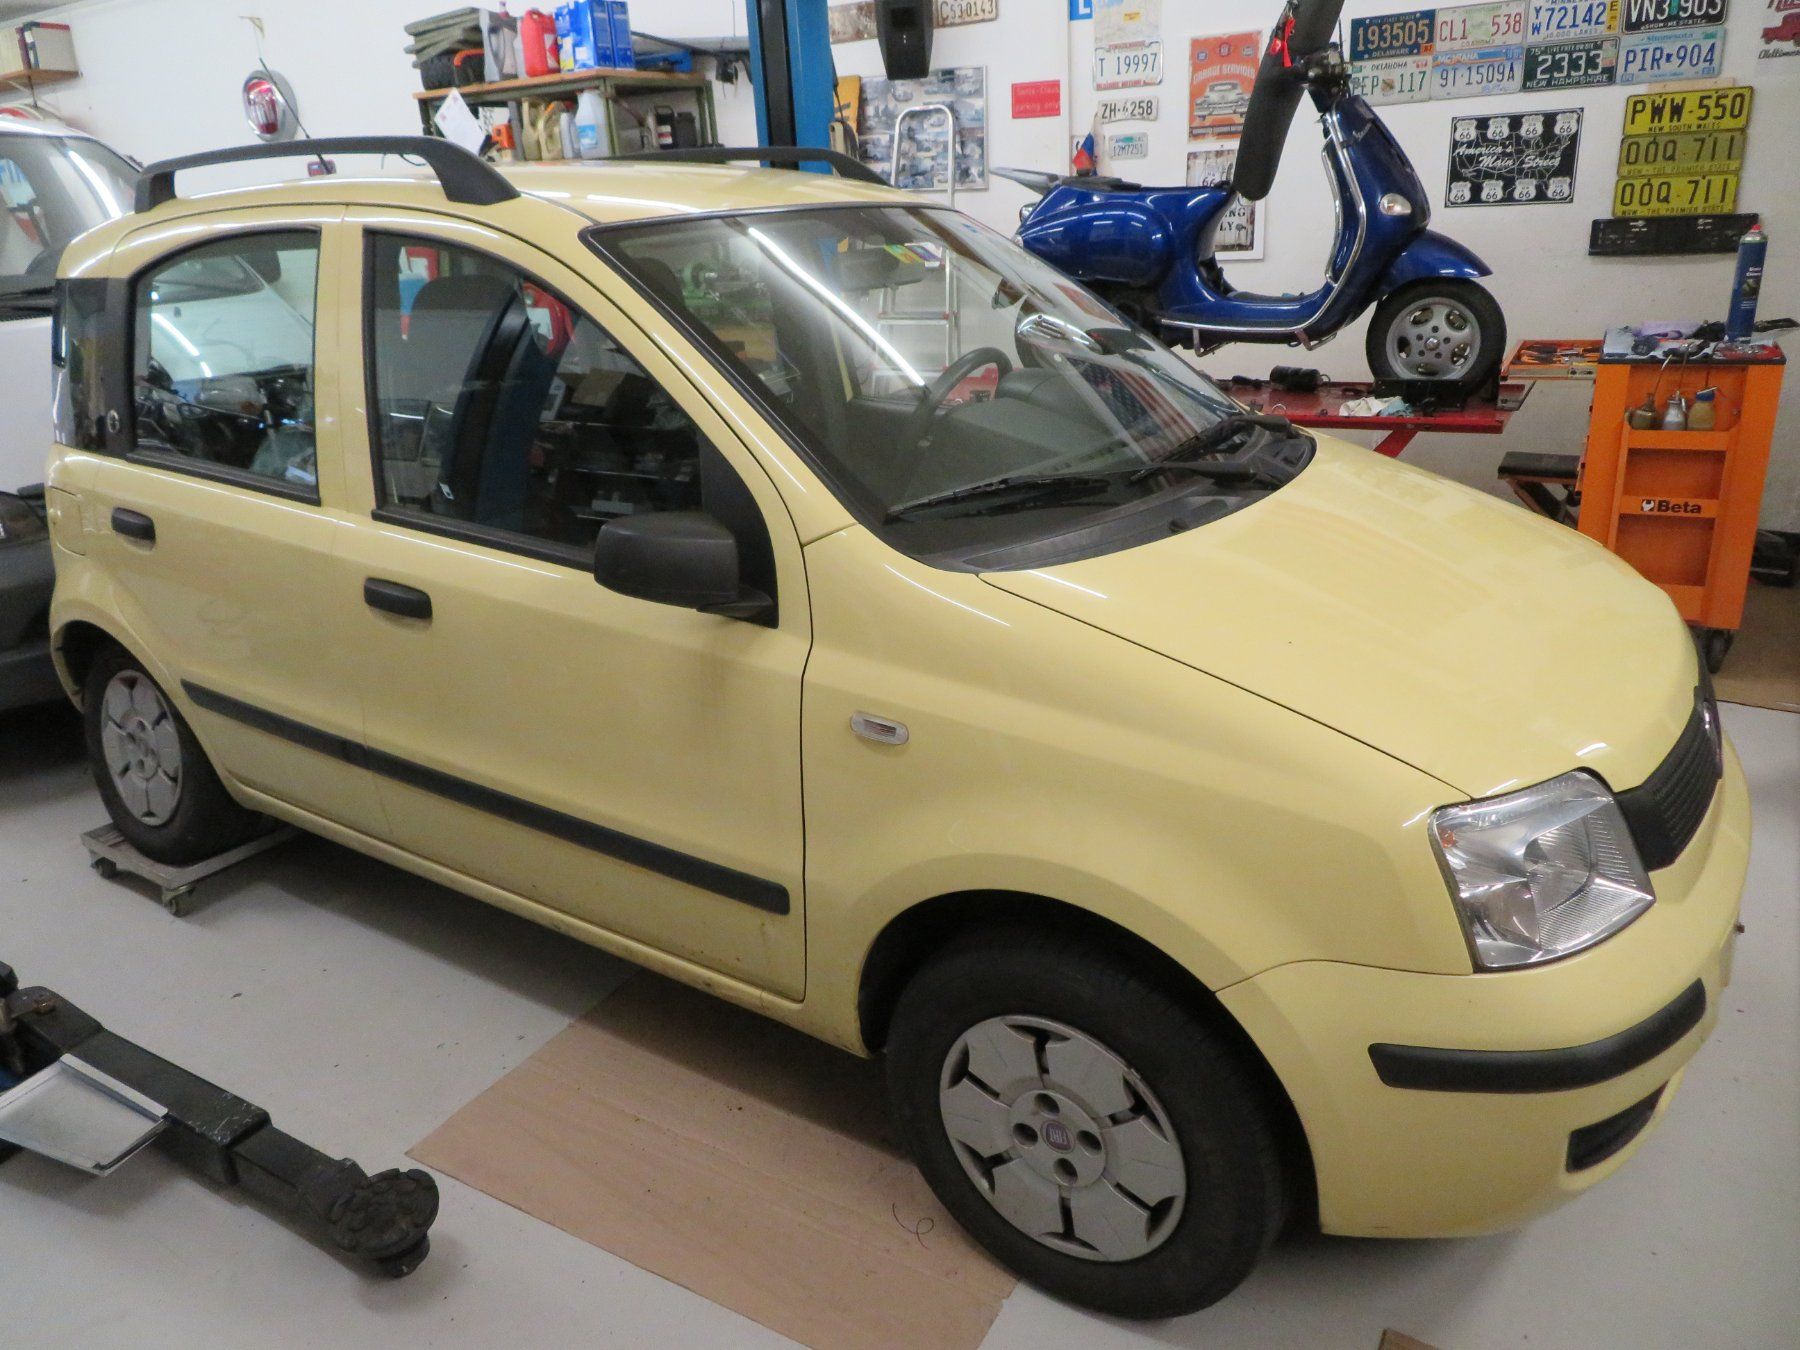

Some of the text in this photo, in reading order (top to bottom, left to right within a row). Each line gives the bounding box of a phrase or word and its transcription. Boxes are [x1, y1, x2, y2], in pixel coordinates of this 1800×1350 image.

[1545, 2, 1607, 31] 72142
[1439, 12, 1522, 42] CL1 538
[1357, 18, 1430, 51] 193505
[1372, 48, 1409, 58] DELAWARE
[1099, 52, 1158, 77] T 19997
[1371, 61, 1408, 71] OKLAHOMA
[1536, 50, 1603, 79] 2333
[1398, 71, 1427, 93] 117
[1527, 74, 1608, 88] NEW HAMPSHIRE
[1559, 125, 1572, 134] 66
[1669, 123, 1692, 131] SOUTH
[1696, 121, 1721, 129] WALES
[1459, 132, 1472, 140] 66
[1492, 129, 1504, 138] 66
[1525, 128, 1538, 136] 66
[1453, 141, 1513, 156] America's
[1479, 154, 1561, 168] Main Street
[1453, 193, 1466, 201] 66
[1485, 191, 1498, 200] 66
[1518, 190, 1531, 199] 66
[1552, 188, 1565, 197] 66
[1657, 500, 1702, 514] Beta
